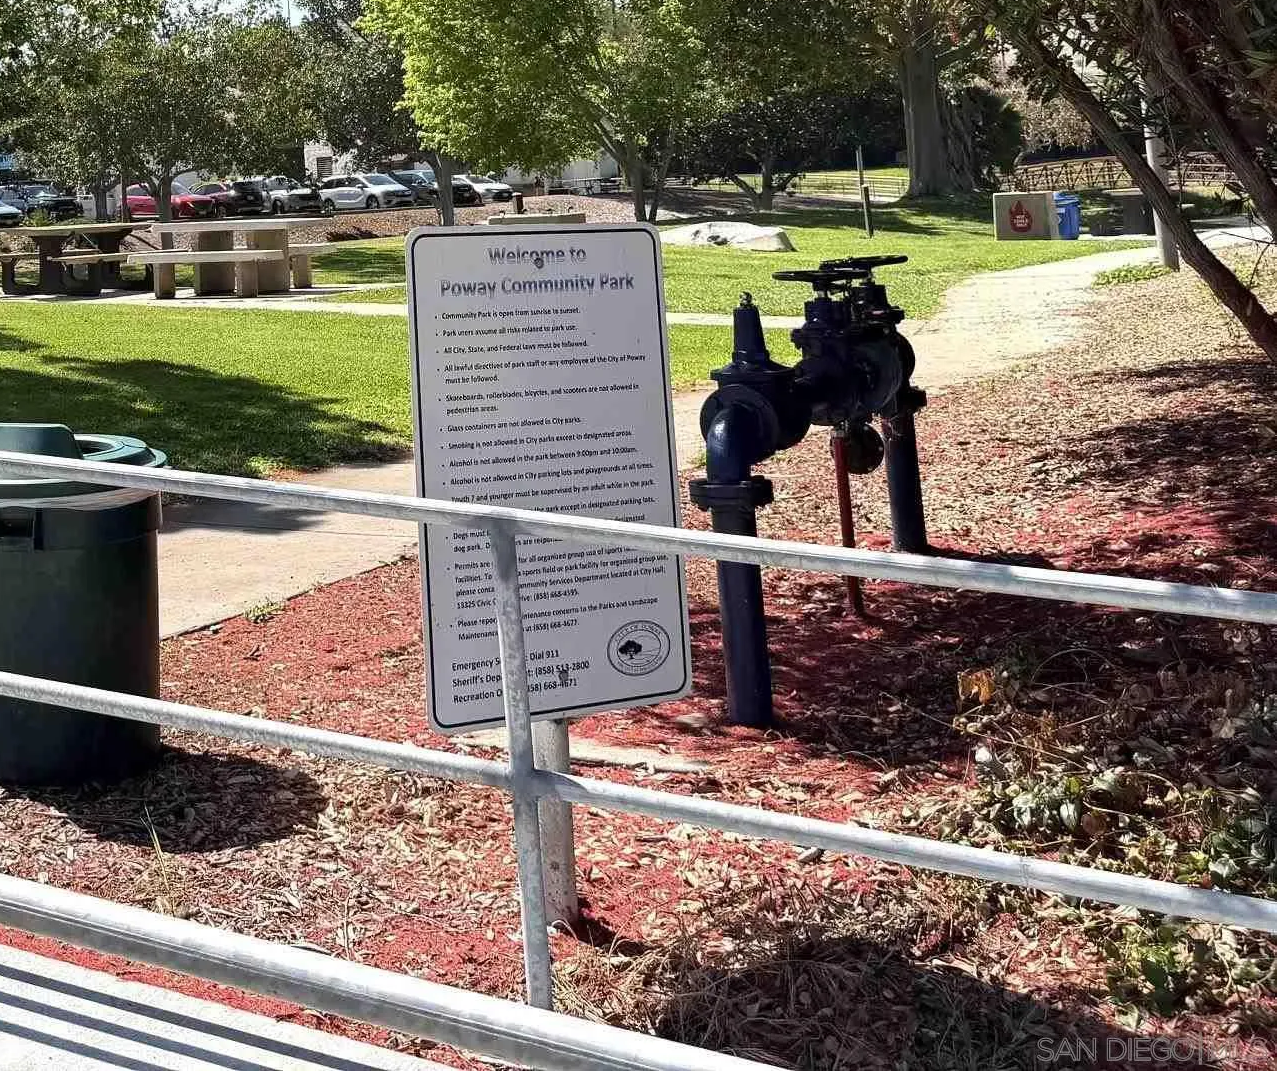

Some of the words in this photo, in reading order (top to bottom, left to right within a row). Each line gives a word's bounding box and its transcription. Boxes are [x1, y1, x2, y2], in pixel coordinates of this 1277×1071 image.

[488, 247, 565, 264] Welcome
[569, 247, 586, 262] to
[440, 279, 497, 299] Poway
[501, 274, 595, 295] Community
[599, 272, 634, 290] Park
[441, 311, 477, 319] Community
[529, 650, 544, 660] Dial
[545, 648, 558, 658] 911
[451, 659, 493, 671] Emergency
[535, 664, 553, 677] (858)
[452, 675, 483, 687] Sheriff's
[453, 690, 494, 703] Recreation
